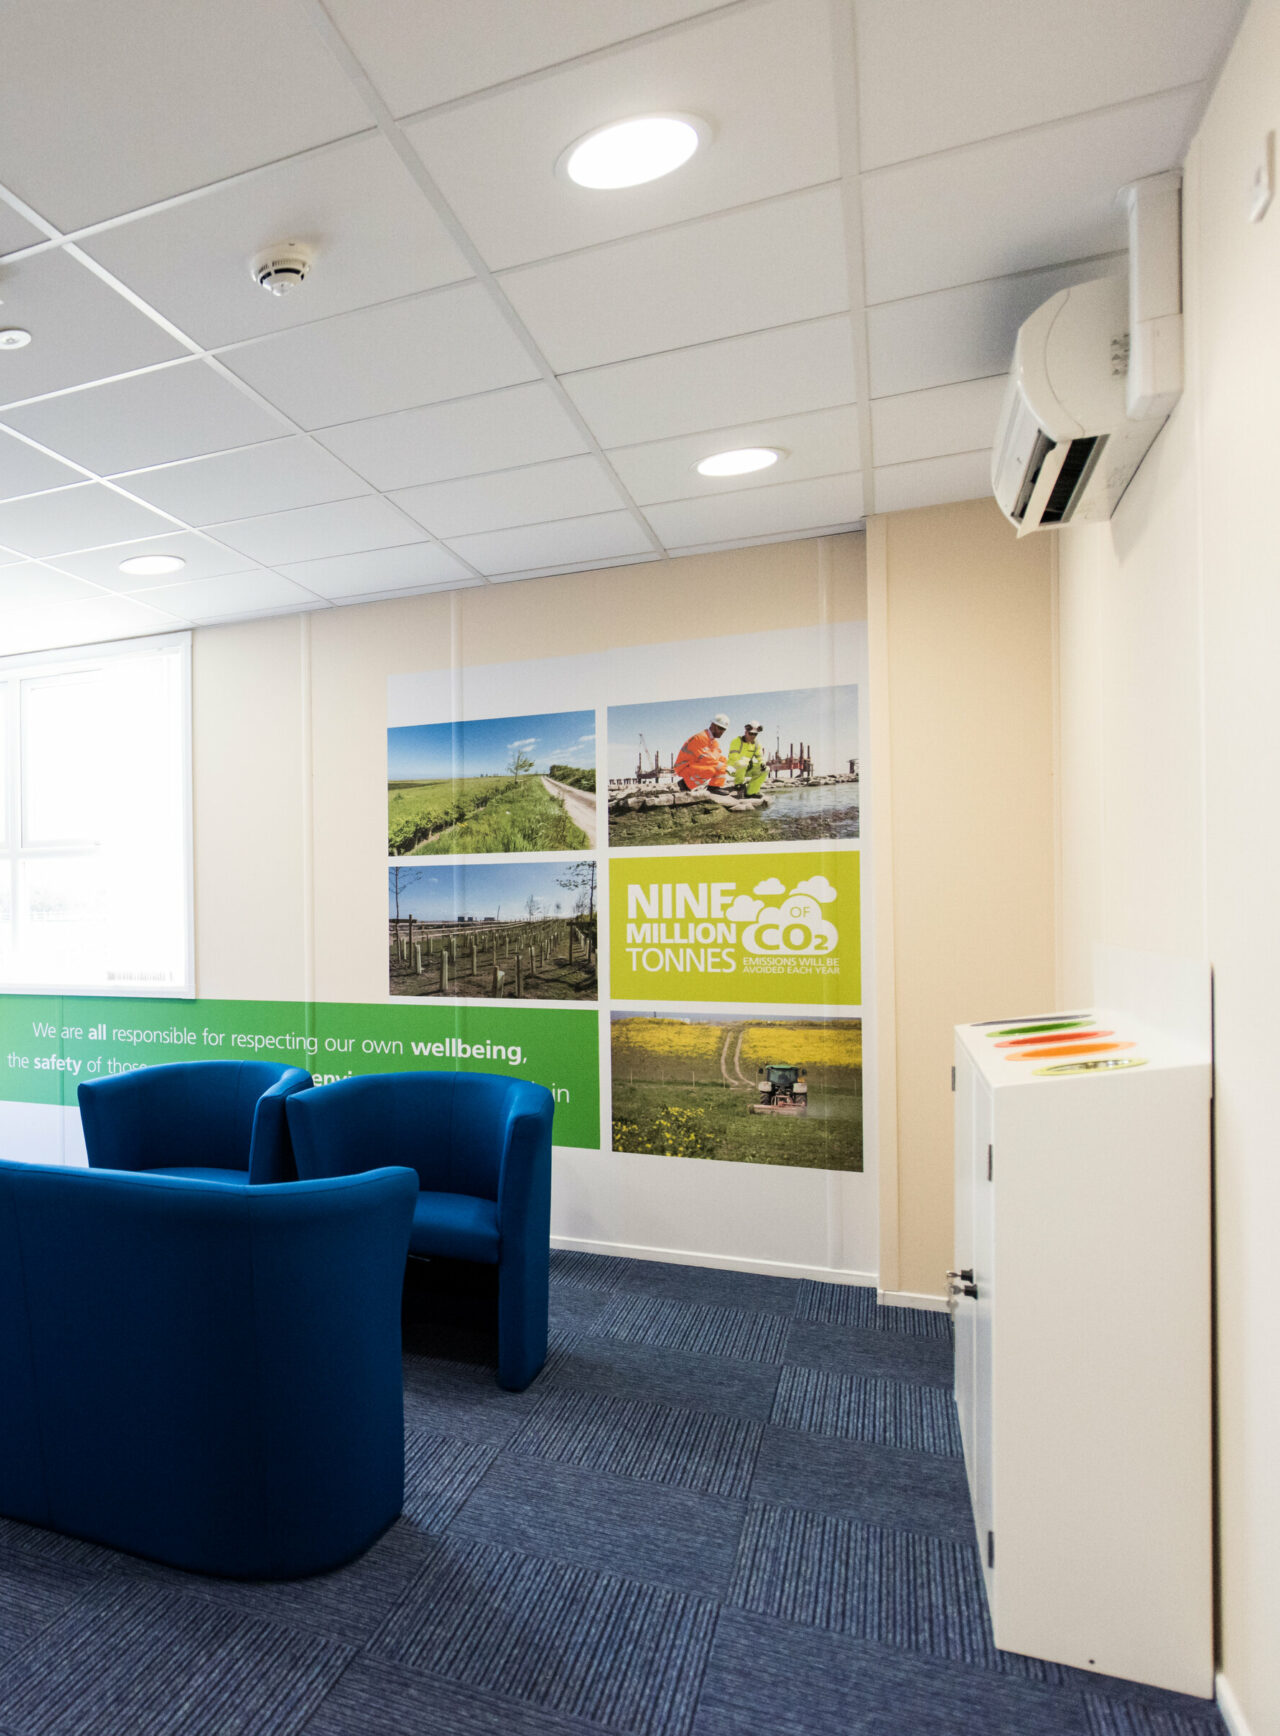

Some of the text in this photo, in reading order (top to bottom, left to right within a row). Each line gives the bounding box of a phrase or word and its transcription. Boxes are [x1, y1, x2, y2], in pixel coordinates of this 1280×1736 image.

[626, 882, 737, 919] NINE
[789, 906, 811, 919] OF
[626, 923, 737, 945] MILLION
[753, 923, 830, 951] CO2
[625, 947, 737, 974] TONNES
[743, 957, 840, 967] EMISSIONS WILL BE
[743, 966, 840, 975] AVOIDED EACH YEAR
[32, 1021, 528, 1065] We are all responsible for respecting our own wellbeing,
[7, 1051, 30, 1069] the
[34, 1054, 83, 1076] safety
[86, 1056, 102, 1073] of
